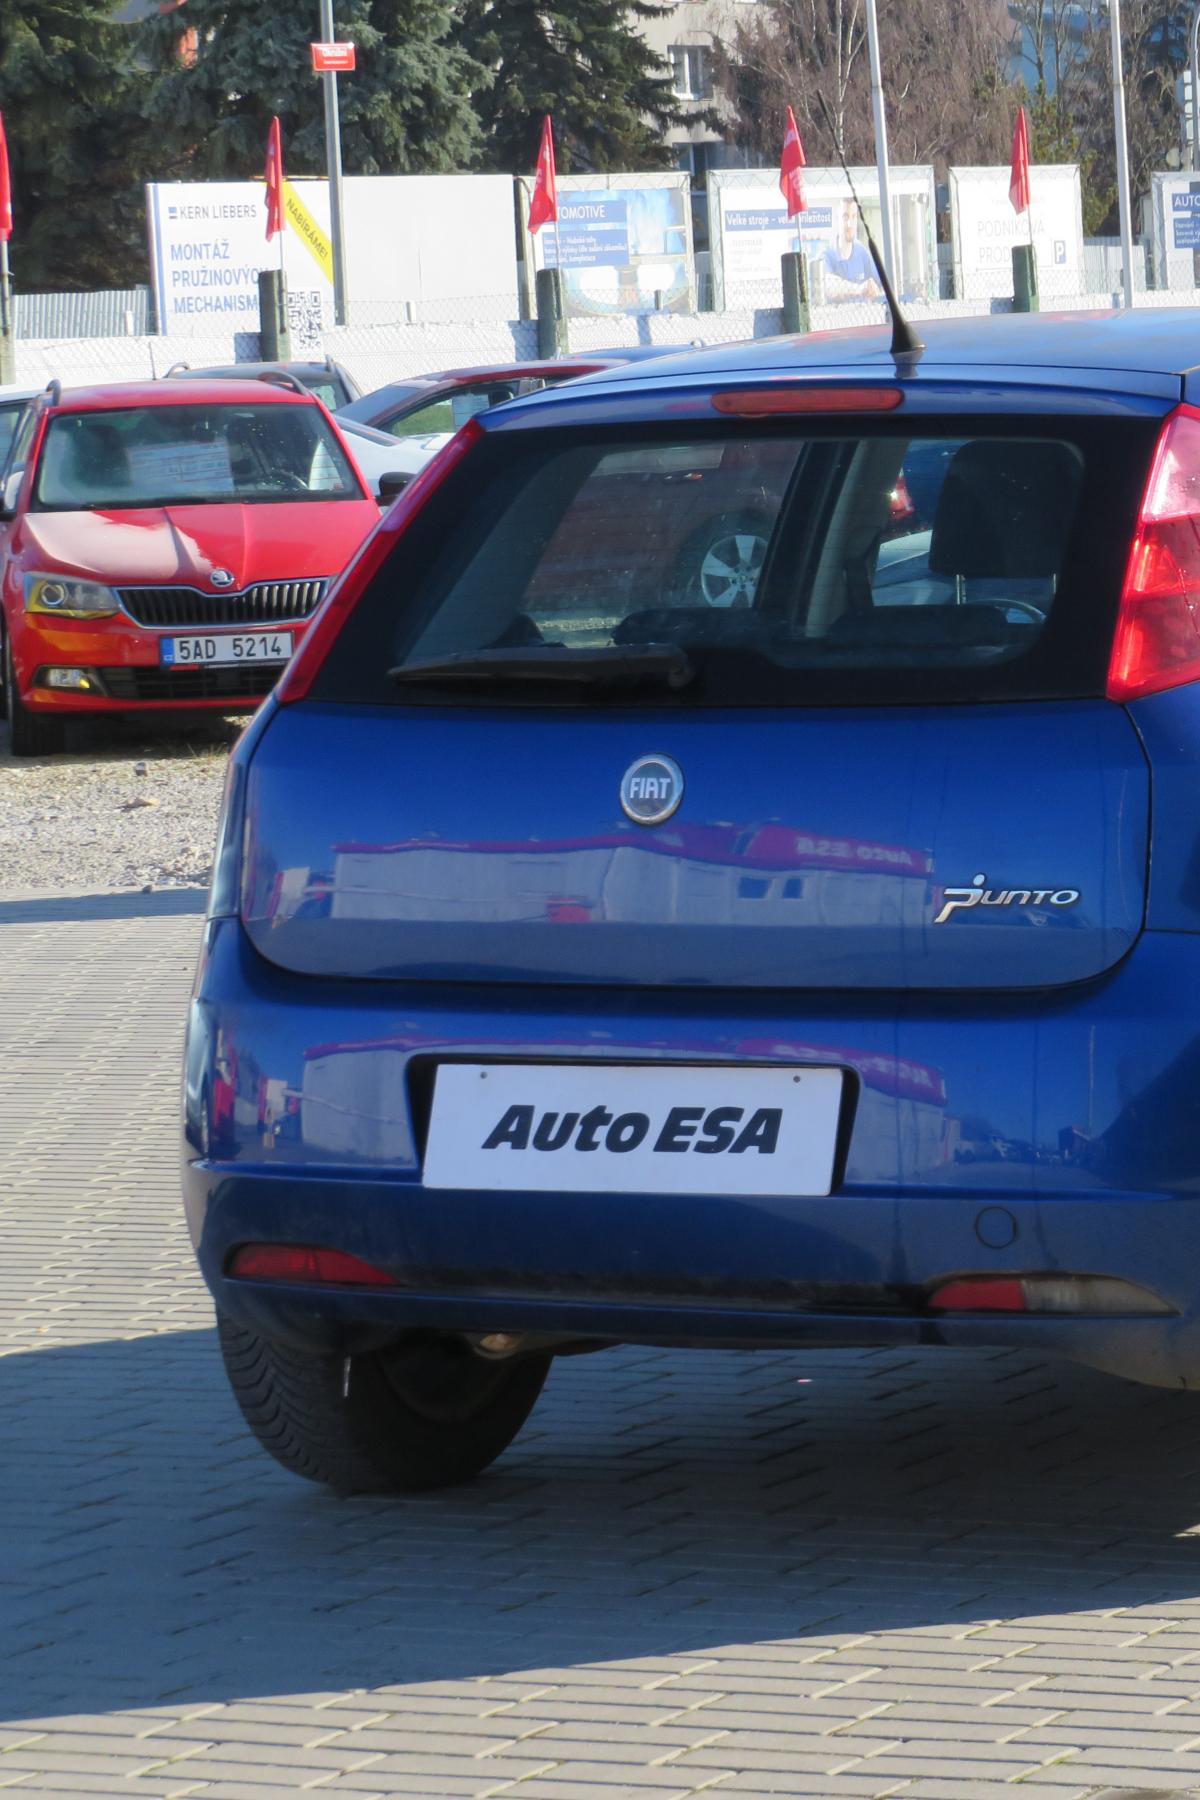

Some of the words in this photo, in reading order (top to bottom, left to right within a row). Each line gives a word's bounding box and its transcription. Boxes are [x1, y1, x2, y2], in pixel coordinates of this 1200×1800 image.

[180, 205, 209, 219] KERN
[213, 204, 257, 219] LIEBERS
[726, 212, 748, 226] Velké
[287, 198, 329, 262] NABÍRÁME!
[171, 239, 230, 261] MONTÁŽ
[978, 246, 1011, 264] PROD
[172, 264, 261, 288] PRUŽINOVÝC
[174, 295, 259, 314] MECHANISM
[179, 639, 216, 660] 5AD
[232, 636, 282, 658] 5214
[629, 777, 672, 799] FIAT
[481, 1104, 650, 1153] Auto
[652, 1106, 783, 1154] ESA
